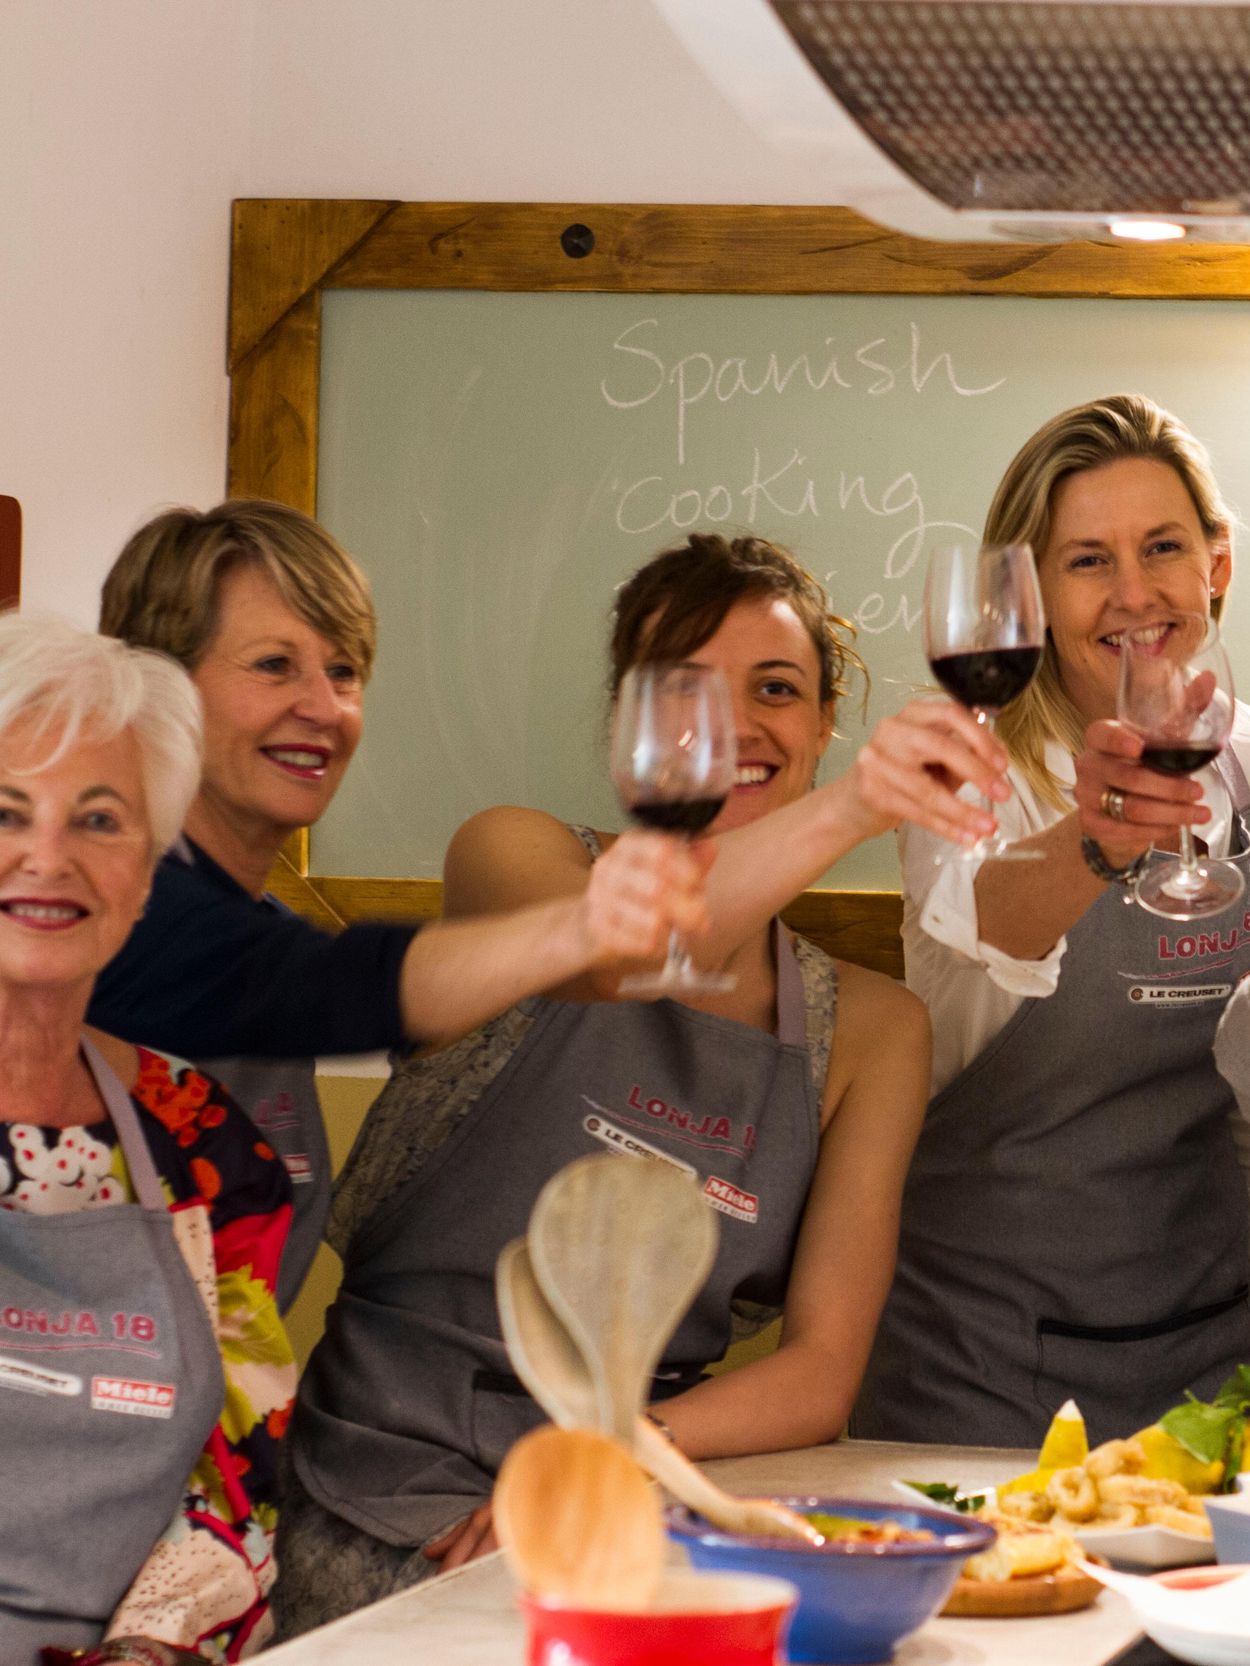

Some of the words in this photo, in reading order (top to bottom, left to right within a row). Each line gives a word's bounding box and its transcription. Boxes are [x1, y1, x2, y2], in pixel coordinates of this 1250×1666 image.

[601, 318, 1007, 464] Spanish
[1158, 928, 1238, 960] LONJ
[1149, 990, 1165, 998] LE
[1168, 988, 1224, 998] CREUSET
[627, 1085, 732, 1140] LONJA
[743, 1124, 757, 1149] 1
[709, 1179, 755, 1211] Miele
[0, 1307, 98, 1337] ONJA
[112, 1311, 156, 1342] 18
[96, 1381, 171, 1404] Miele
